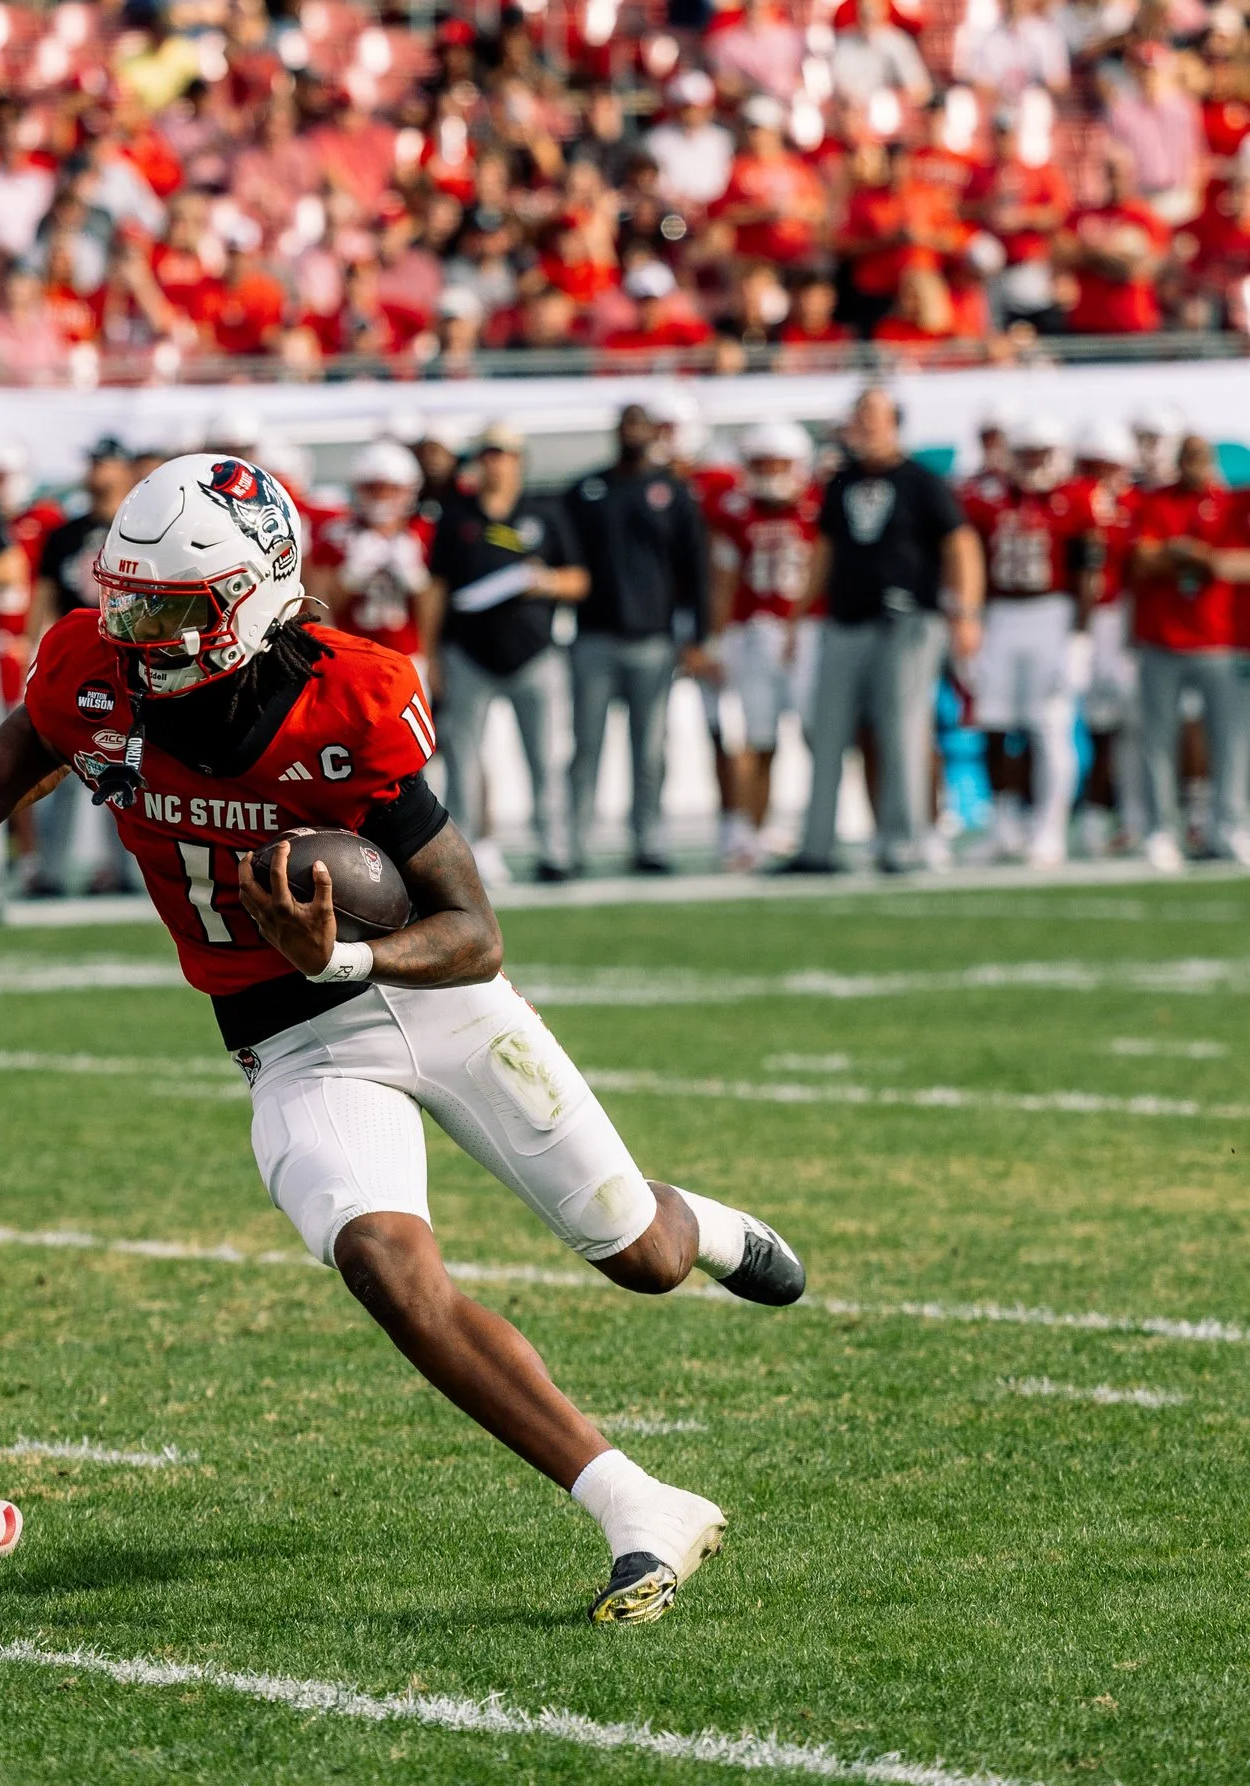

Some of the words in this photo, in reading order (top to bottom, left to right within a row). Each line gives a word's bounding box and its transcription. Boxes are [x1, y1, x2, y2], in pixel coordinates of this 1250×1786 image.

[118, 559, 139, 575] HTT
[78, 696, 115, 711] WILSON
[87, 690, 108, 700] PAYTON
[400, 692, 436, 760] 11
[98, 734, 125, 744] ACC
[125, 737, 143, 770] XTRND
[320, 745, 352, 780] C
[144, 792, 182, 824] NC
[190, 798, 279, 831] STATE
